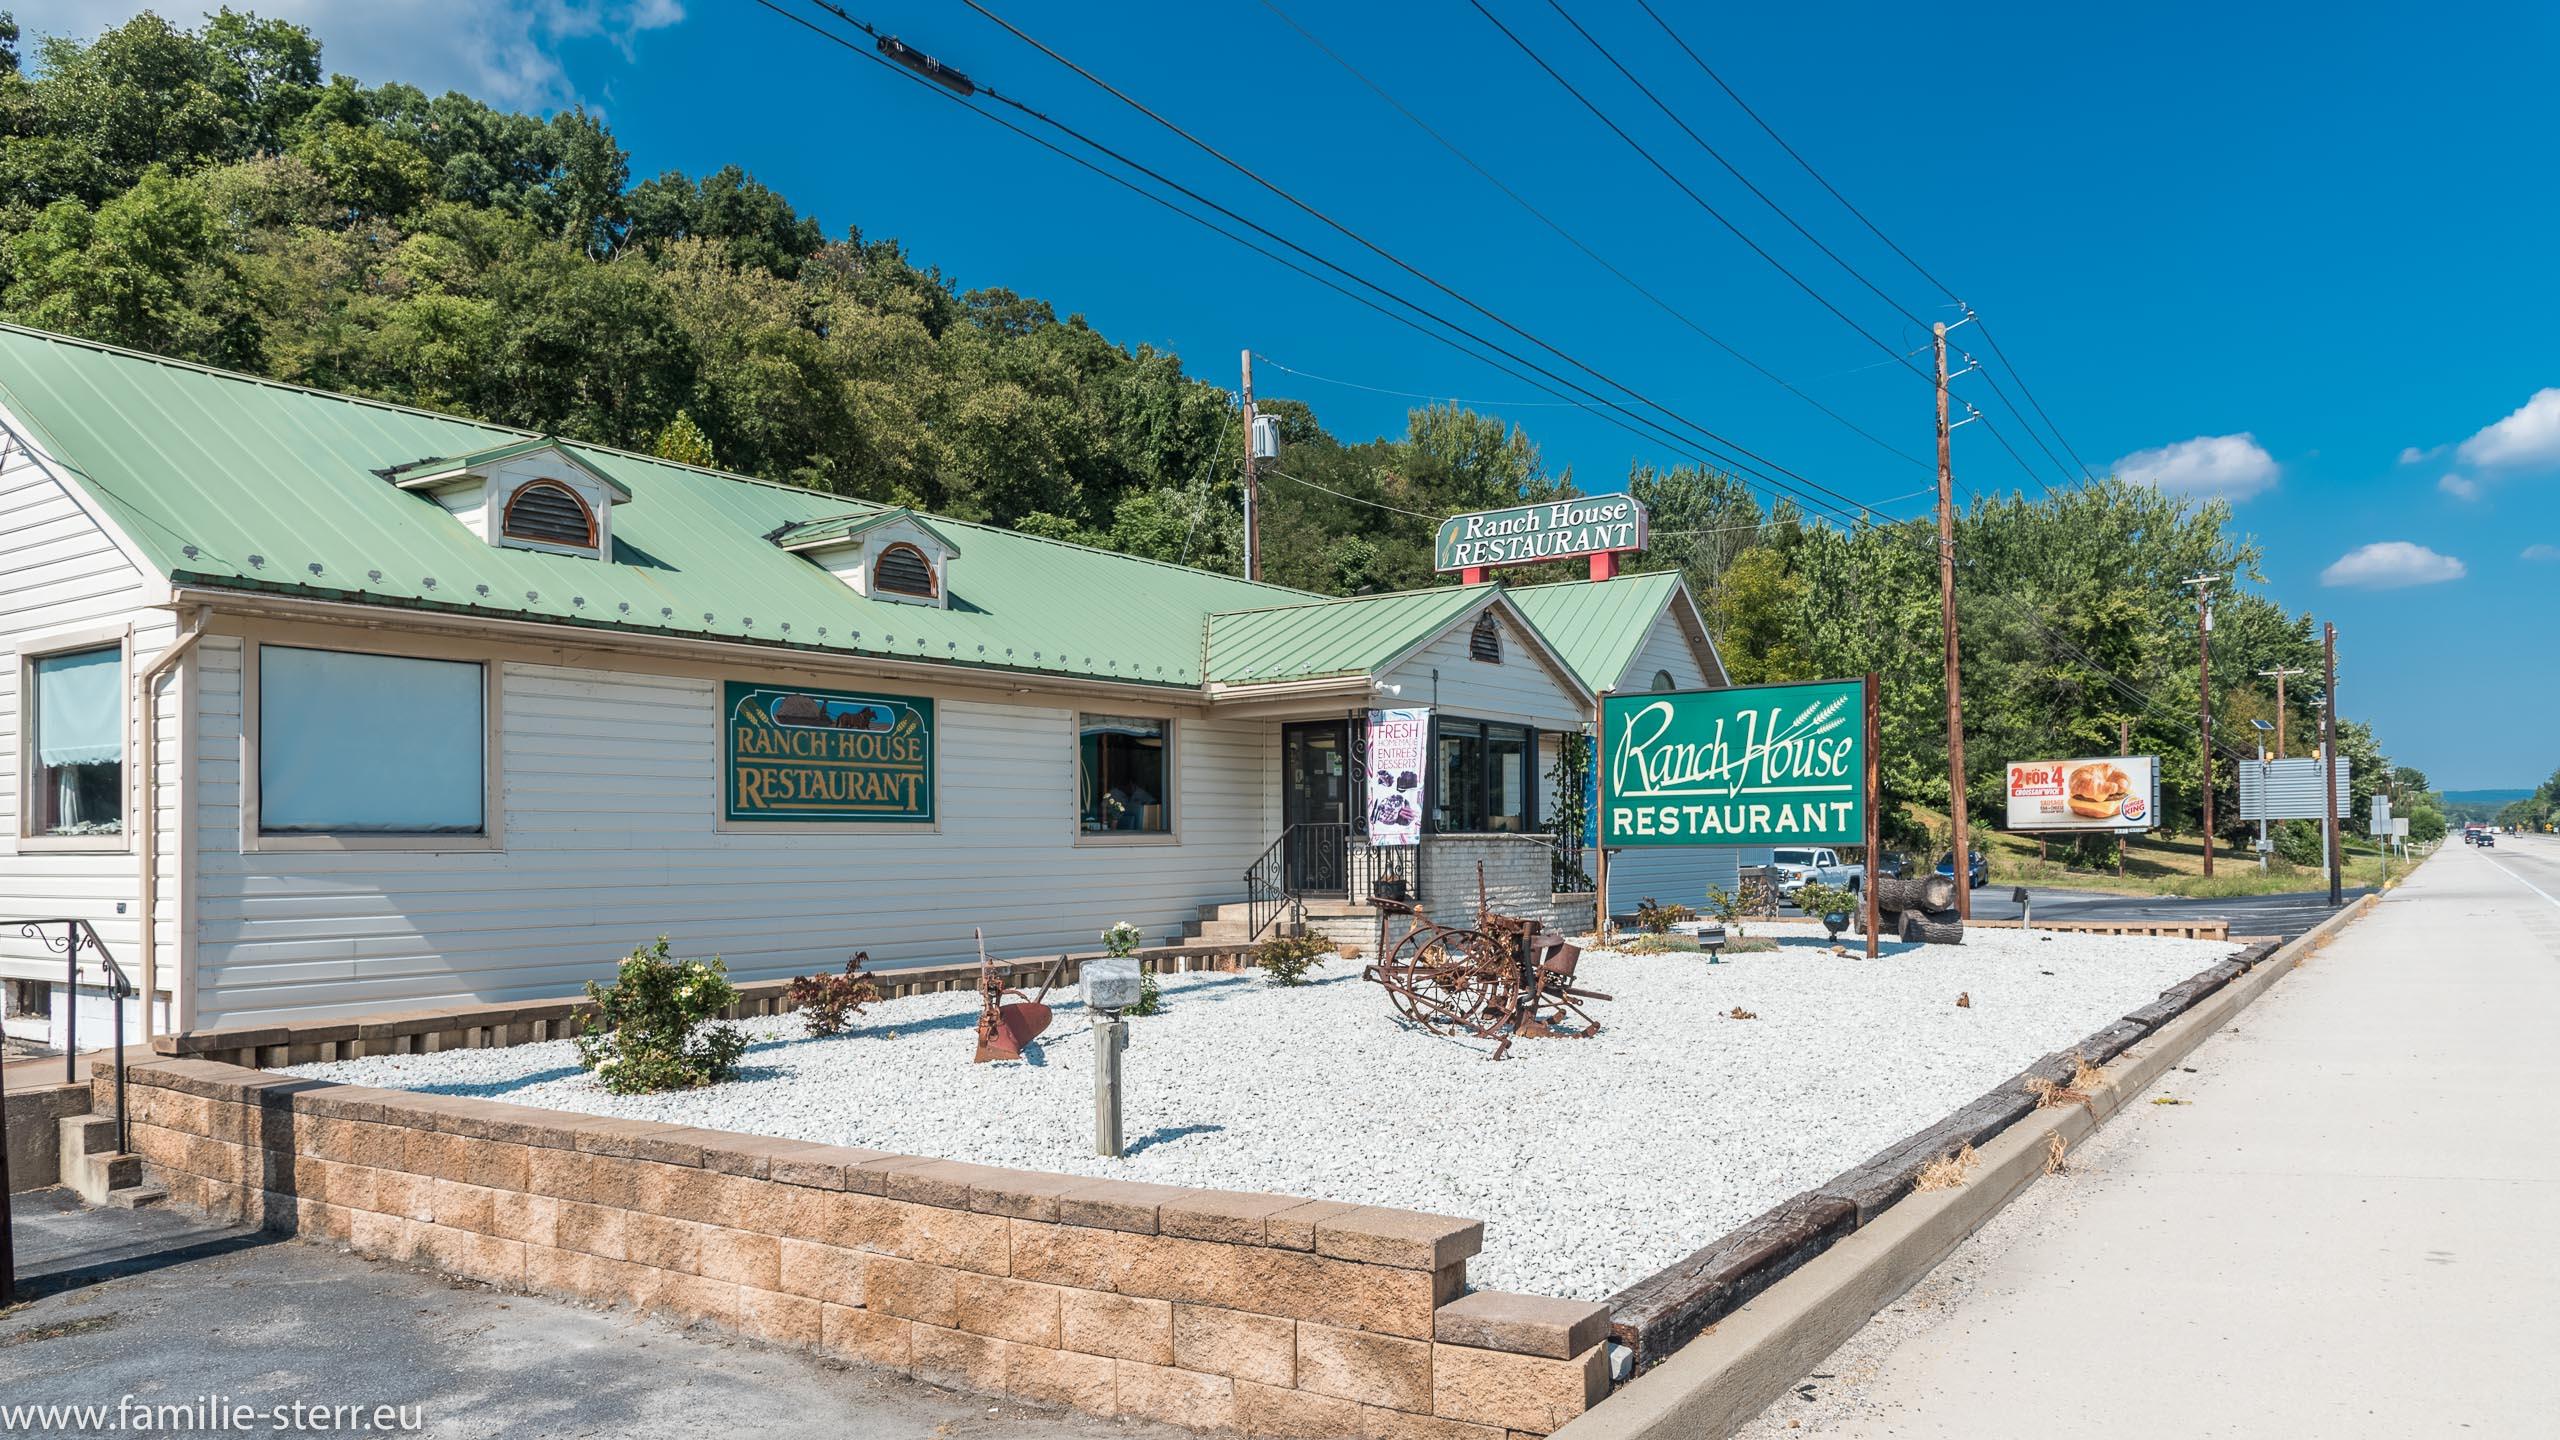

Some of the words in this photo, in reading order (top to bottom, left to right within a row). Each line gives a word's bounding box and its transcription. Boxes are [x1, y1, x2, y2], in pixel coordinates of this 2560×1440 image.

[1465, 509, 1540, 541] Ranch
[1547, 502, 1628, 530] House
[1452, 523, 1634, 567] RESTAURANT
[737, 727, 828, 757] RANCH
[837, 733, 923, 762] HOUSE
[1378, 723, 1419, 738] FRESH
[1377, 759, 1417, 769] DESSERTS
[1378, 747, 1418, 759] ENTREES
[1613, 700, 1731, 799] Ranch
[1729, 707, 1853, 800] House
[736, 767, 924, 811] RESTAURANT
[2011, 767, 2023, 788] 2
[1613, 801, 1854, 836] RESTAURANT
[2124, 804, 2145, 815] KING
